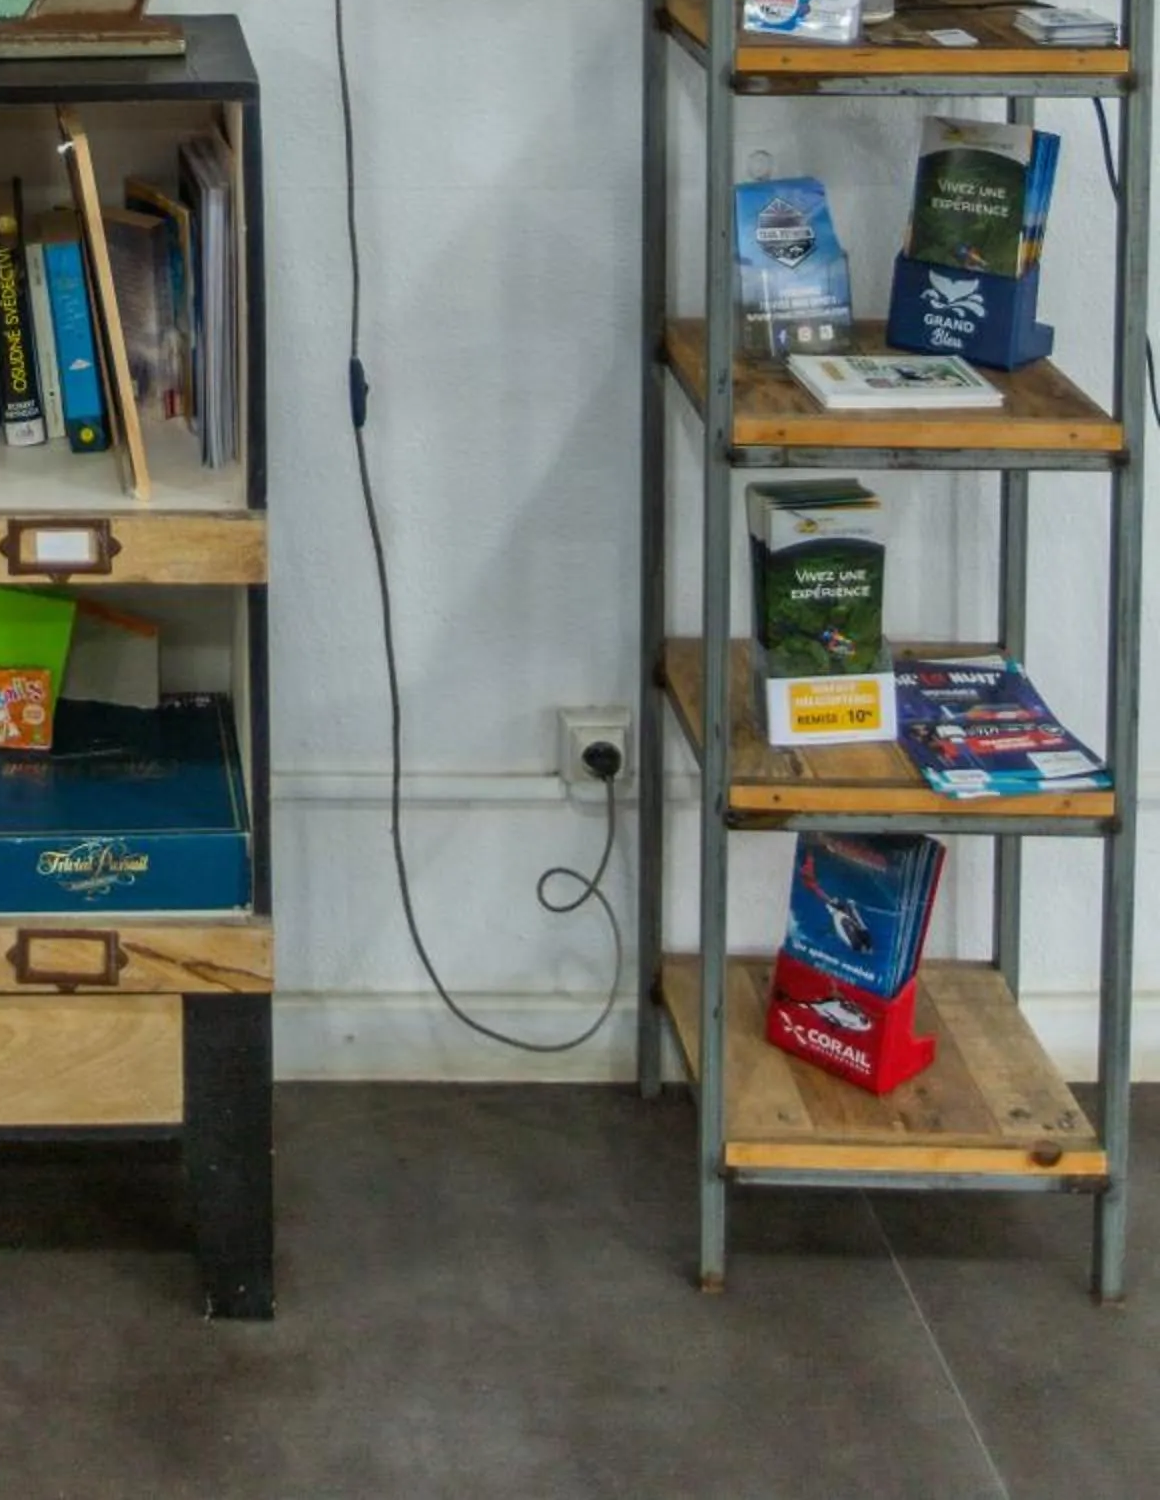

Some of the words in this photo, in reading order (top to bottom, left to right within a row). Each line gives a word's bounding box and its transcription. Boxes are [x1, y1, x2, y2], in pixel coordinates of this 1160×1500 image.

[937, 178, 976, 195] VIVEZ
[979, 185, 1006, 199] UNE
[923, 313, 975, 334] GRAND
[795, 569, 834, 584] VIVEZ
[838, 568, 867, 582] UNE
[790, 582, 871, 600] EXPÉRIENCE
[37, 849, 93, 875] Trivial
[94, 844, 149, 876] Pursuit
[807, 1028, 871, 1068] CORAIL
